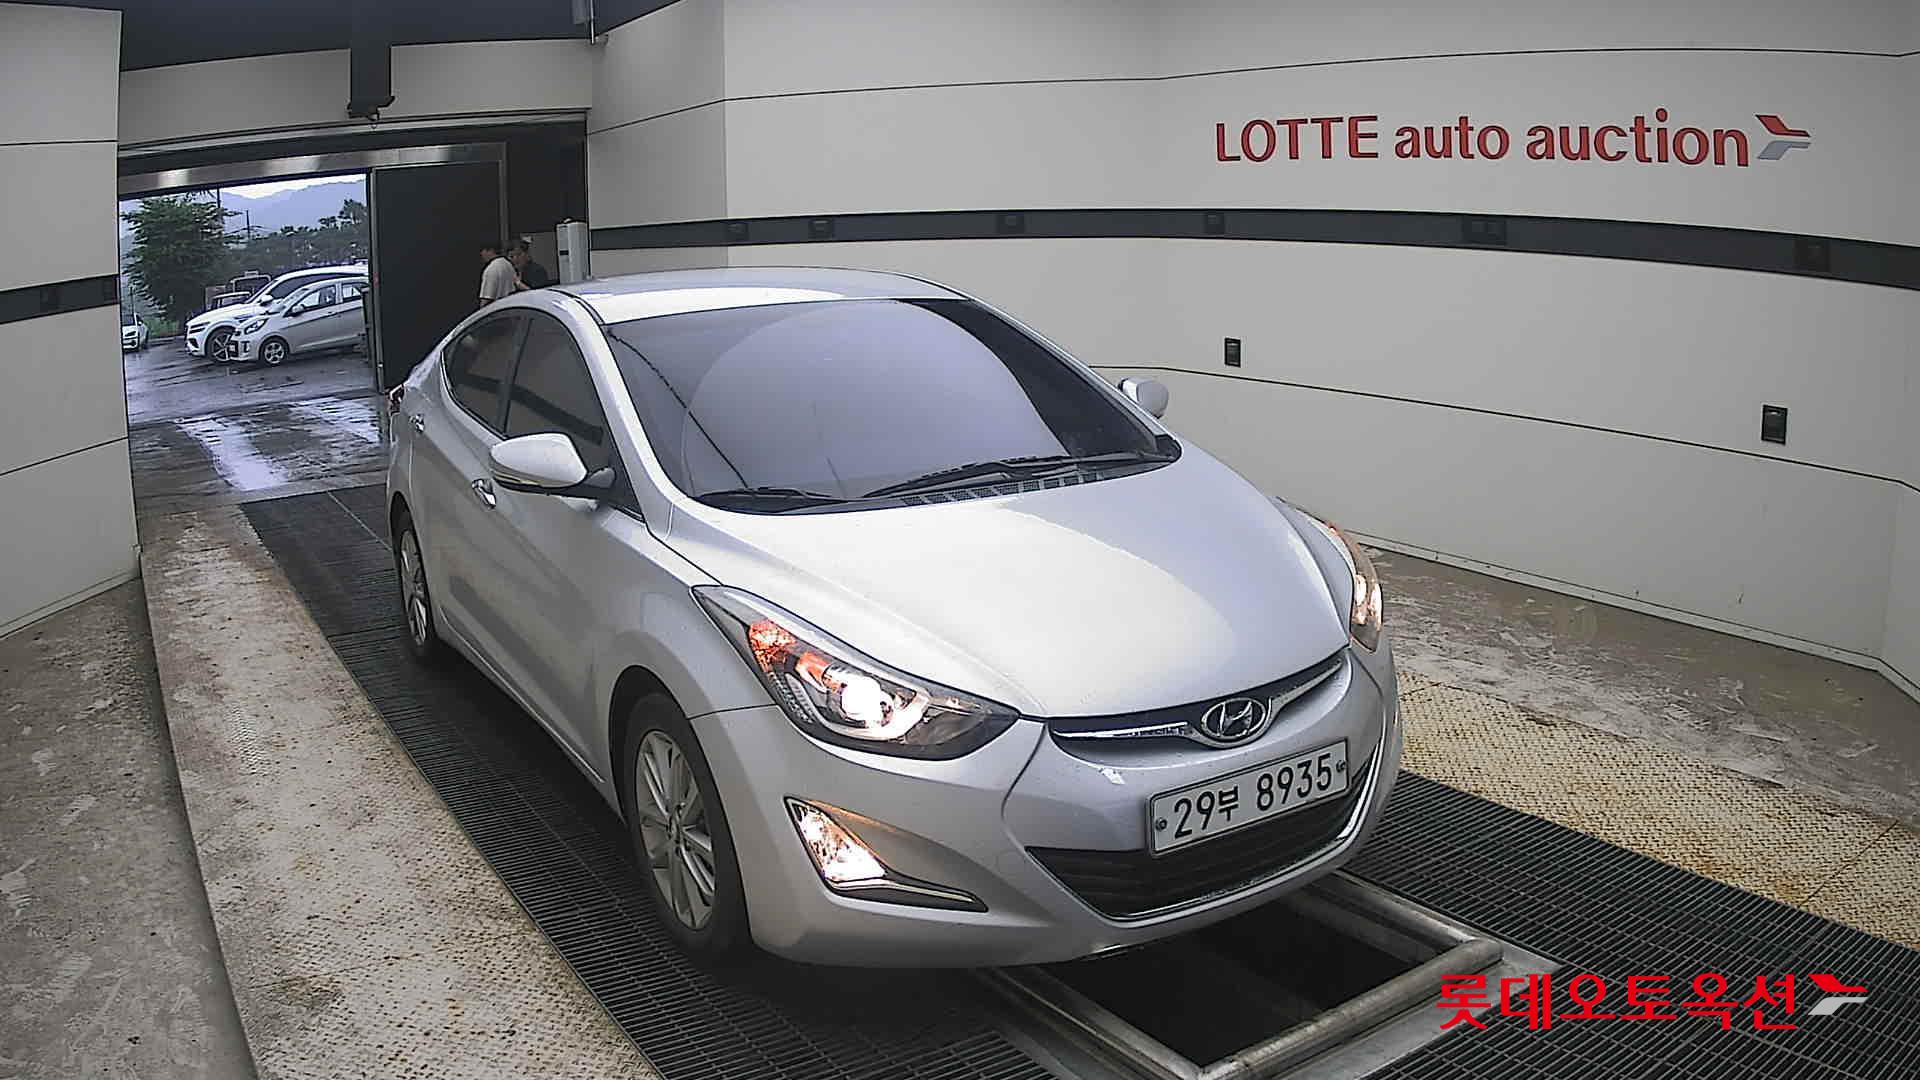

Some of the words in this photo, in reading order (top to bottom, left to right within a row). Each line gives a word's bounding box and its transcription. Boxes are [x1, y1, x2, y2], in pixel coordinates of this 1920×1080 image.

[1215, 115, 1379, 162] LOTTE
[1394, 115, 1511, 161] auto
[1526, 107, 1751, 167] auction
[1173, 785, 1240, 839] 29부
[1256, 752, 1332, 812] 8935
